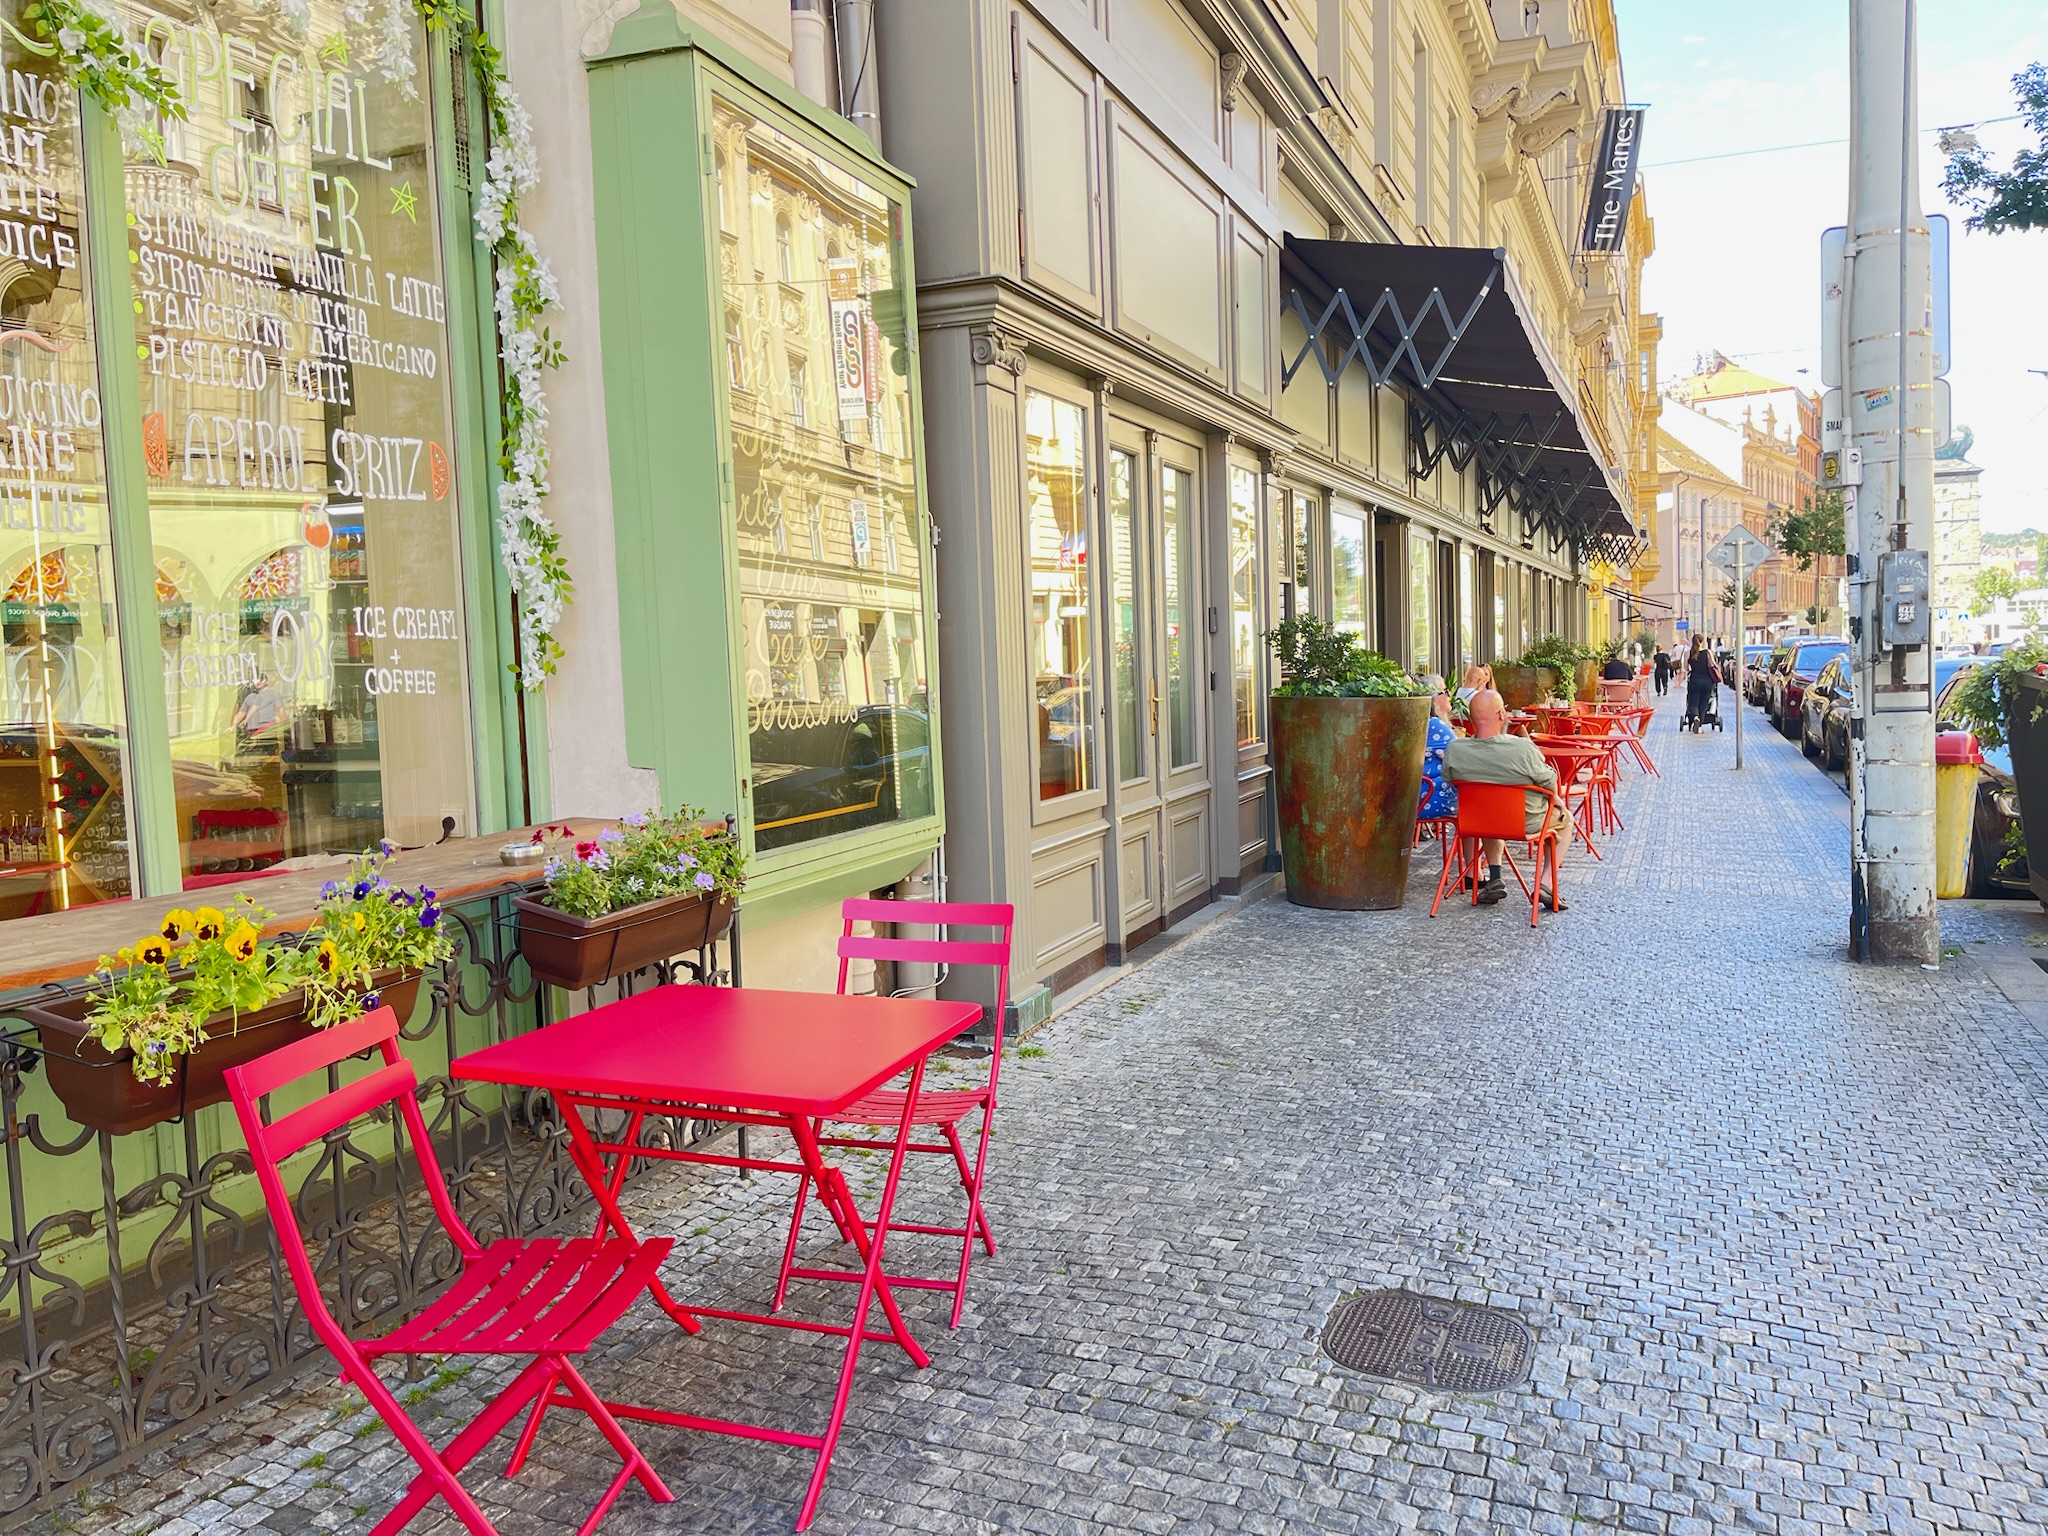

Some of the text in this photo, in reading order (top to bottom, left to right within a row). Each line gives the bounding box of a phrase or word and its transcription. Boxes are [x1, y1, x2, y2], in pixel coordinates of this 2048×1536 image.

[145, 17, 392, 171] SPECIAL
[210, 144, 371, 261] OFFER
[1594, 116, 1634, 243] The Manes
[138, 245, 369, 338] STRAWBERRY MATCHA
[386, 272, 444, 323] LATTE
[143, 290, 436, 379] TANGERINE AMERICANO
[149, 334, 350, 406] PISTACIO LATTE
[182, 413, 426, 502] APEROL SPRITZ
[197, 612, 237, 643] ICE
[271, 608, 330, 683] OR
[353, 606, 458, 640] ICE CREAM
[180, 652, 260, 690] CREAM
[364, 667, 436, 696] COFFEE
